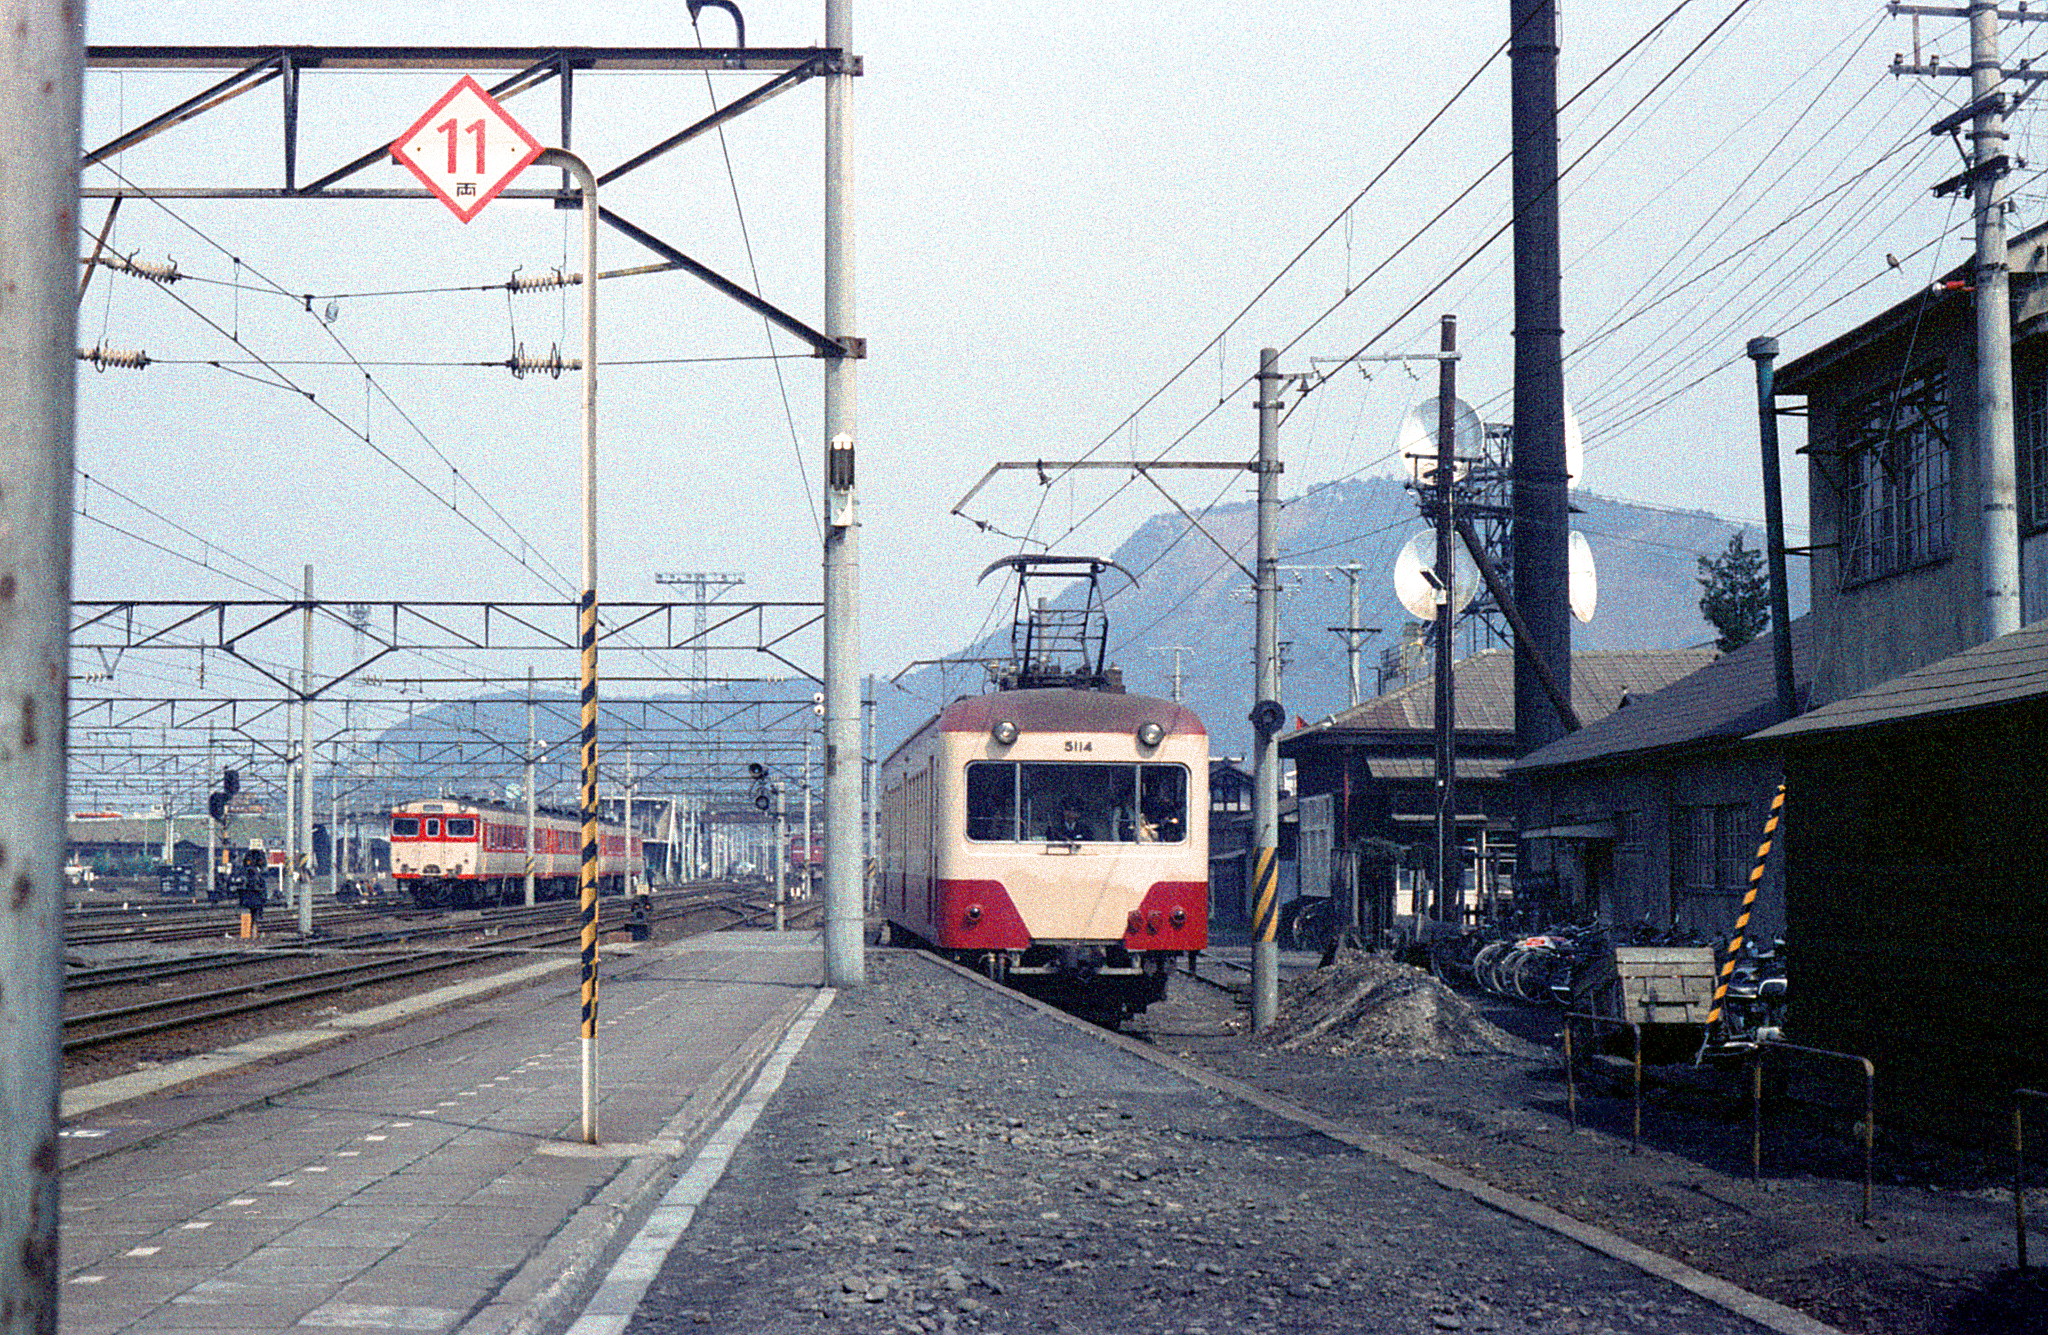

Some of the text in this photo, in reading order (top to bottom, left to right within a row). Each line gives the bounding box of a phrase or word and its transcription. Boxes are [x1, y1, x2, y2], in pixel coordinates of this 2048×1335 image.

[436, 118, 486, 174] 11
[456, 182, 477, 197] 両
[1064, 740, 1093, 752] 5114
